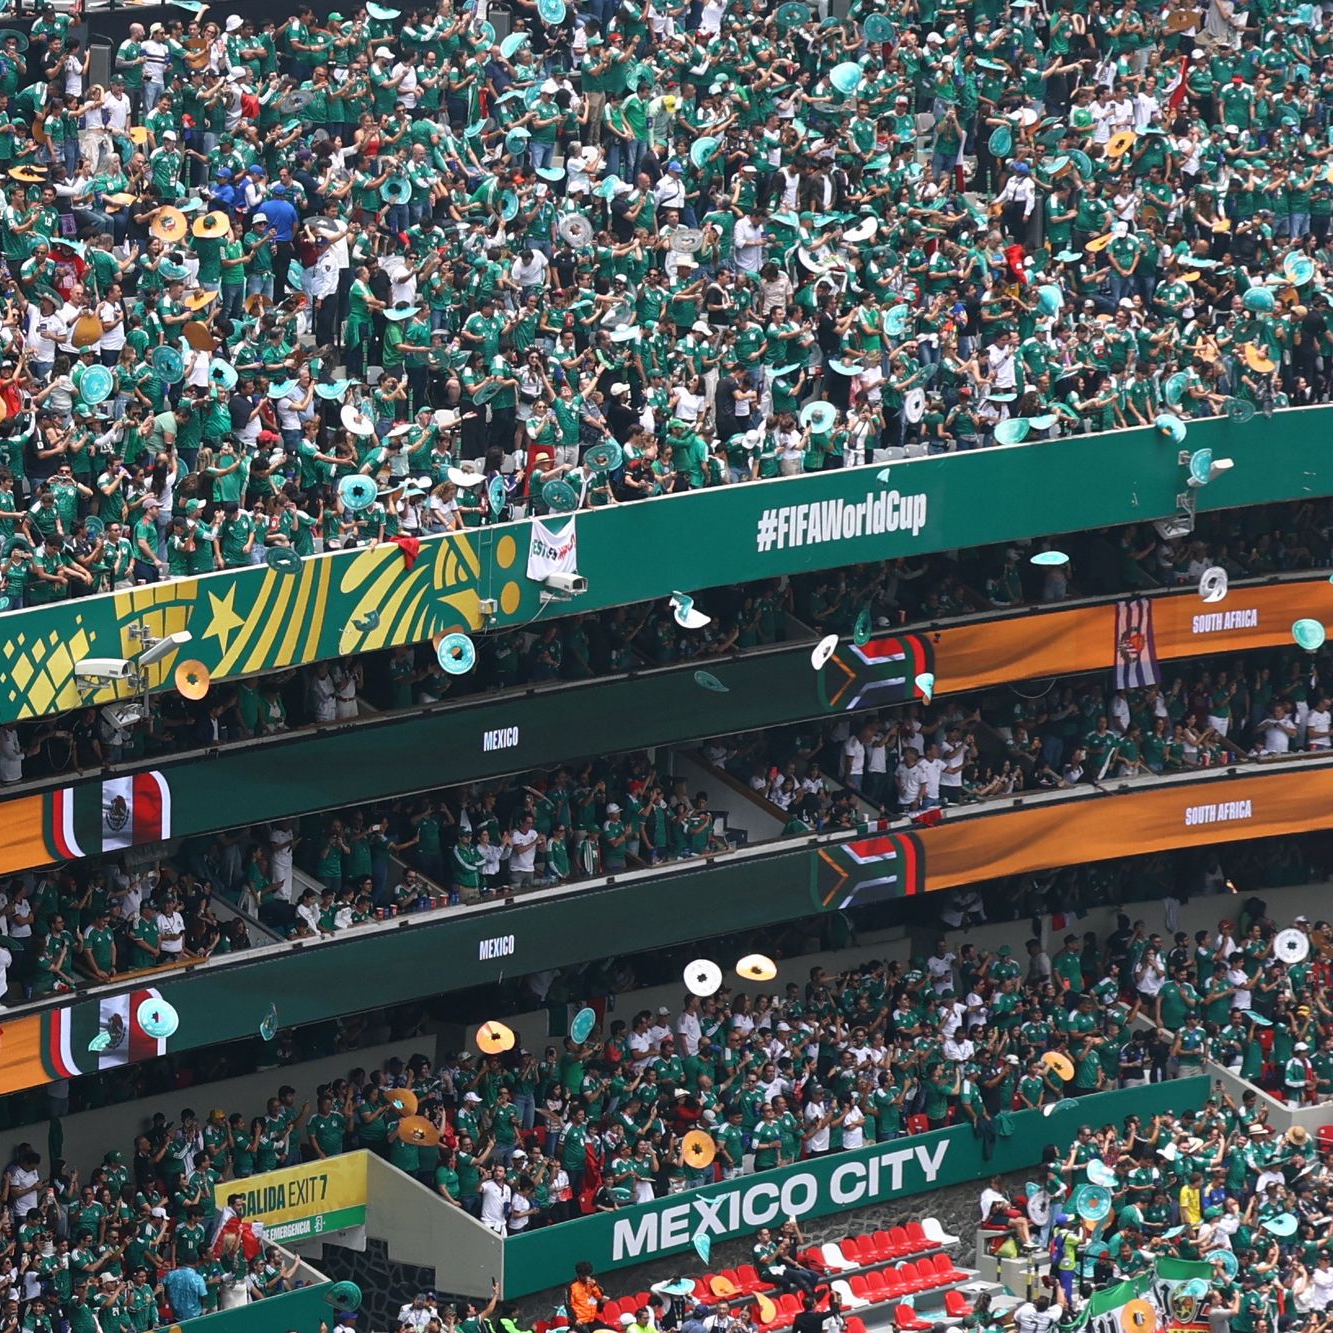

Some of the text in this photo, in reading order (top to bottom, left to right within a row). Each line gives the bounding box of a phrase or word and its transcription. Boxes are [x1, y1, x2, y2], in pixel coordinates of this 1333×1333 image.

[757, 490, 927, 552] #FIFAWorldCup
[1192, 608, 1257, 634] SOUTH AFRICA
[483, 726, 519, 752] MEXICO
[1185, 799, 1252, 826] SOUTH AFRICA
[479, 934, 515, 961] MEXICO
[287, 1175, 318, 1212] EXIT
[318, 1173, 328, 1201] 7
[612, 1139, 950, 1261] MEXICO CITY
[270, 1219, 311, 1240] EMERGENCIA
